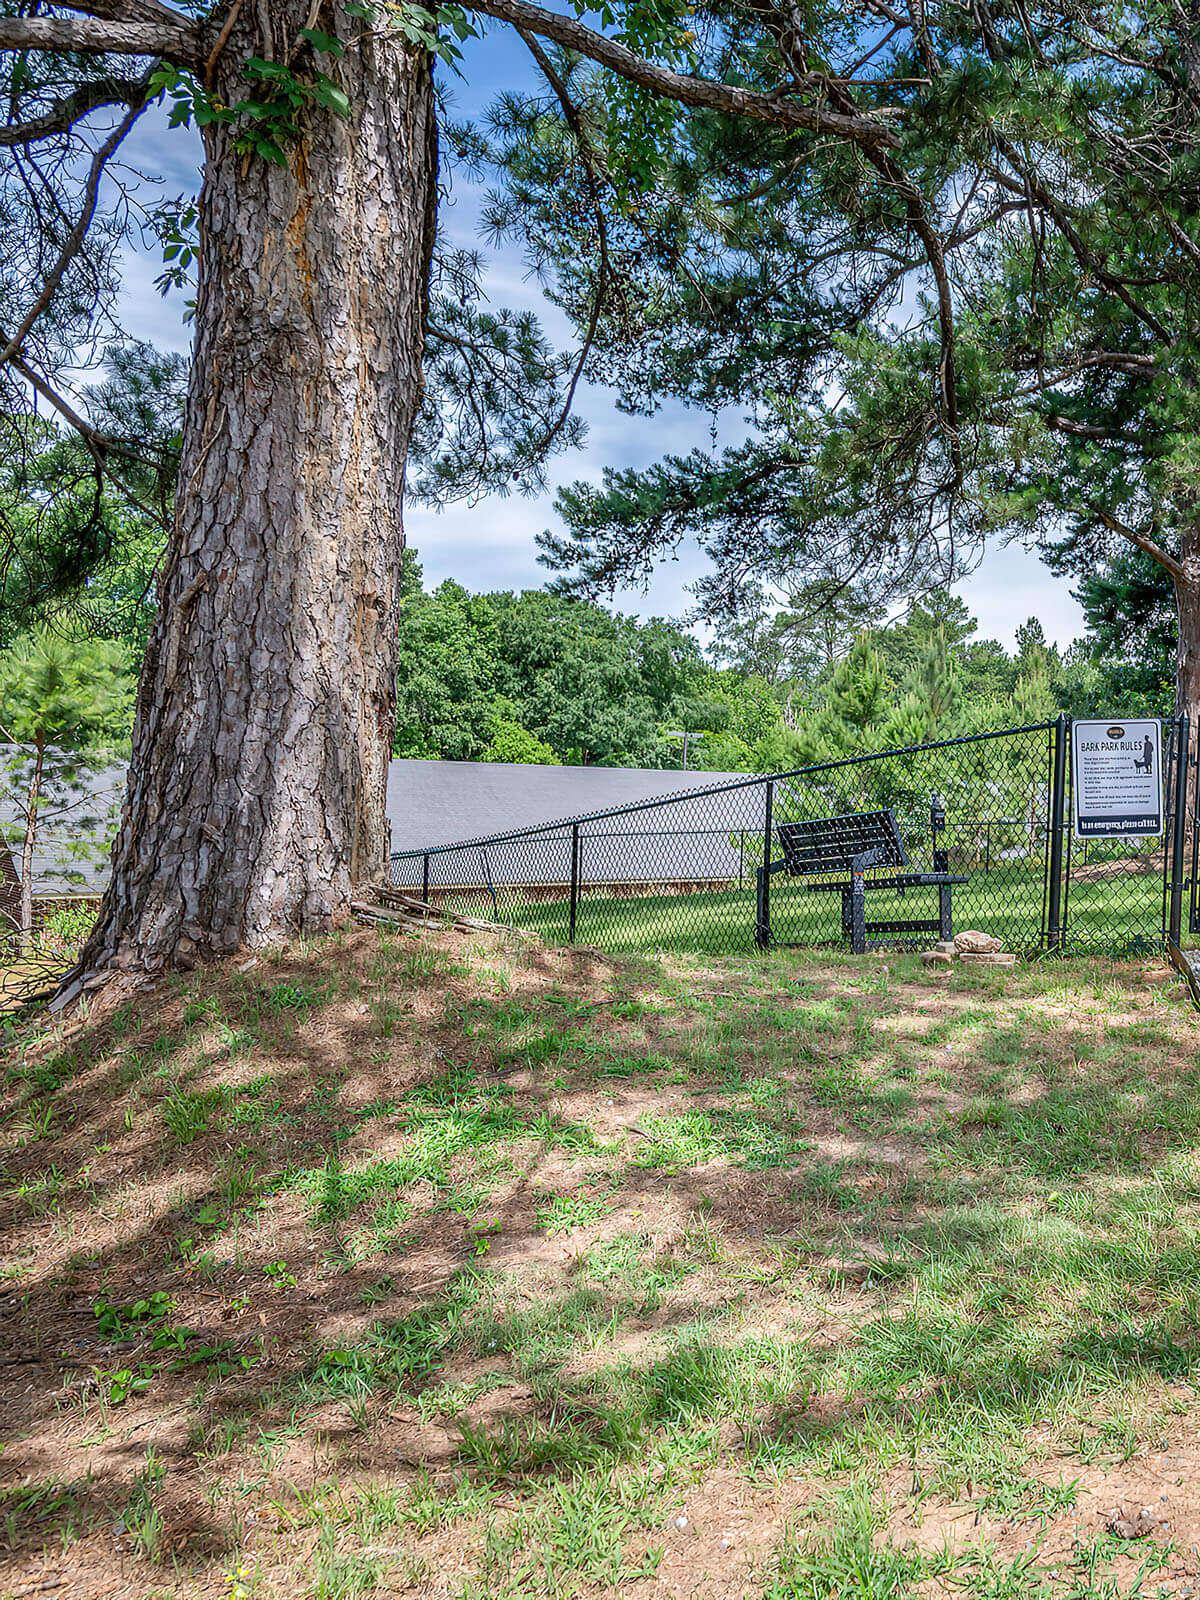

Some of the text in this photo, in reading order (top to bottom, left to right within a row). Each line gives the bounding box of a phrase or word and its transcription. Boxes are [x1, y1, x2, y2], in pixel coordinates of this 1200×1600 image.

[1081, 741, 1143, 752] BARK PARK RULES
